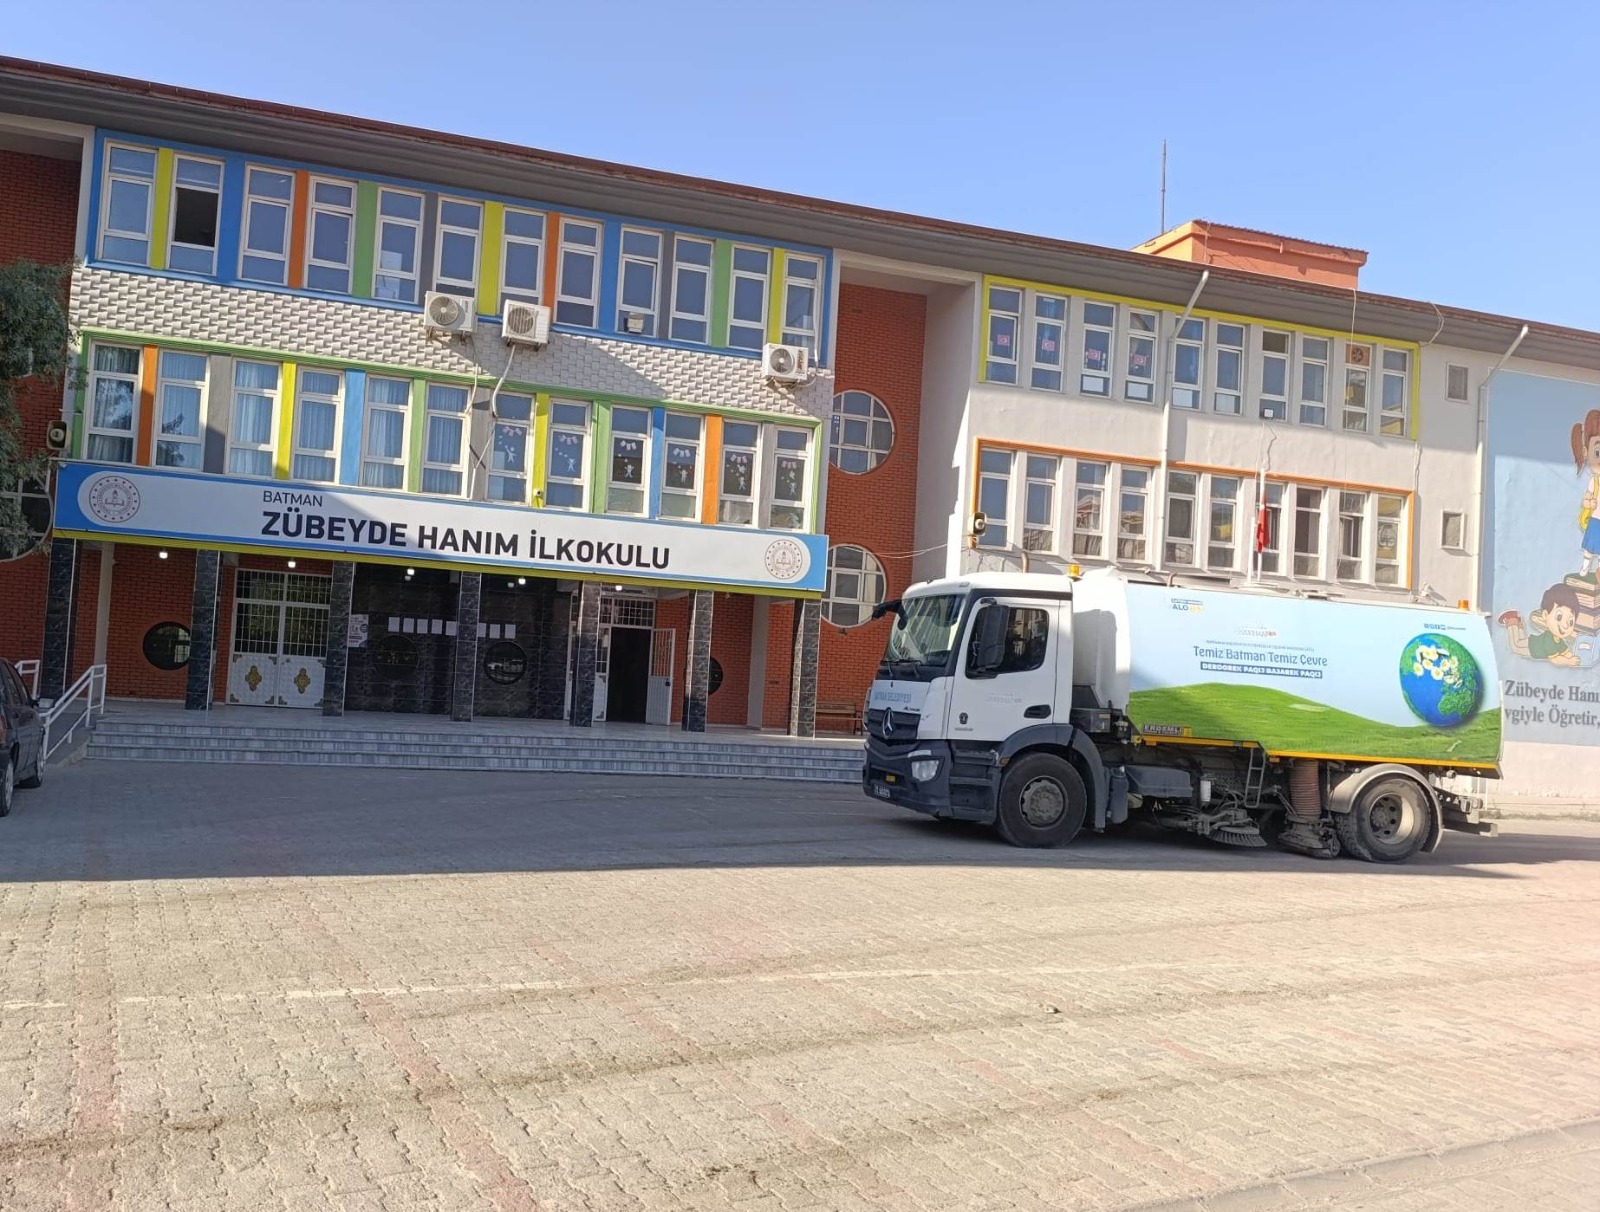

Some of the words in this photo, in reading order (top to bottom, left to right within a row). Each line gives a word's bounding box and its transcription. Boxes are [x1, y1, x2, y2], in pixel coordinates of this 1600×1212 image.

[263, 490, 323, 507] BATMAN
[261, 506, 408, 547] ZÜBEYDE
[417, 525, 519, 557] HANIM
[528, 529, 670, 570] İLKOKULU
[1193, 645, 1224, 659] Temiz
[1226, 648, 1266, 662] Batman
[1267, 651, 1298, 665] Temiz
[1300, 653, 1328, 667] Çevre
[1504, 679, 1564, 703] Zübeyde
[1568, 685, 1600, 703] Hanı
